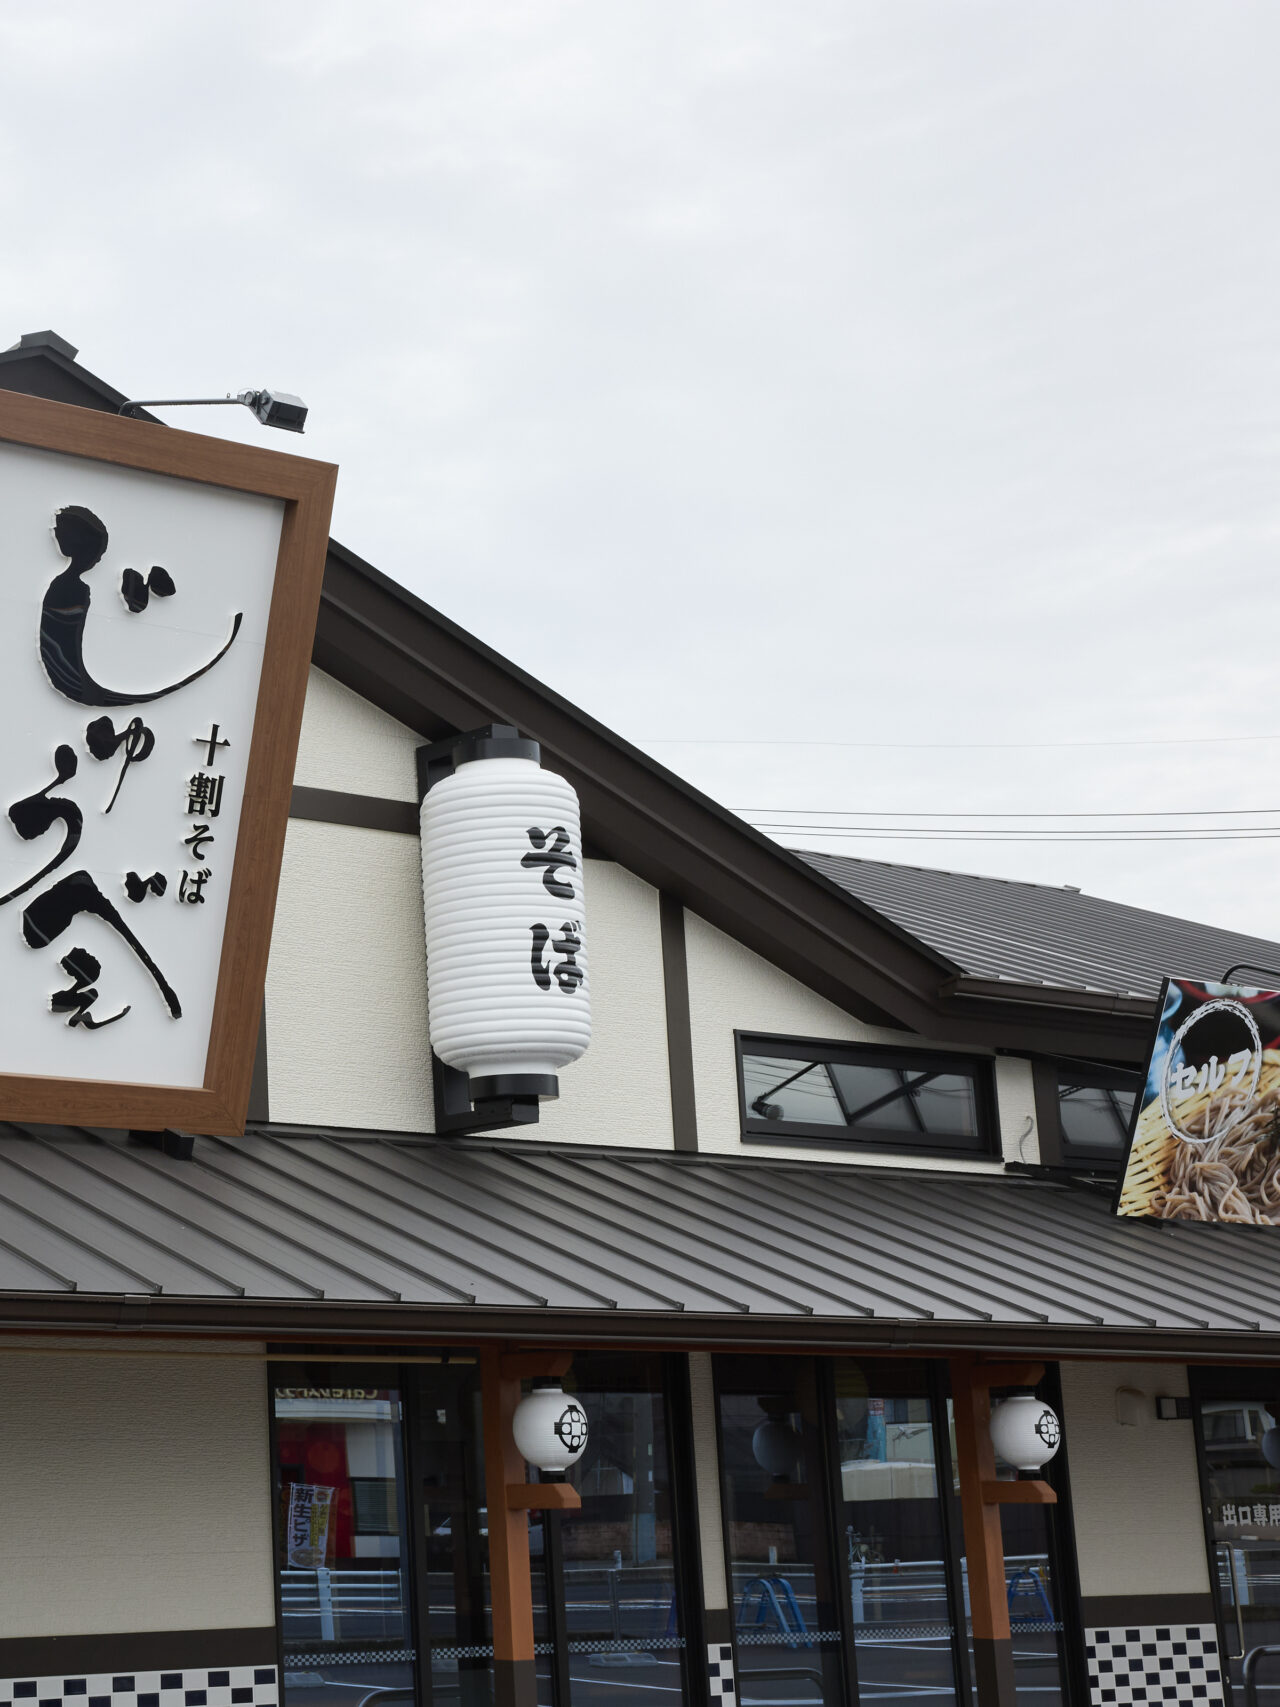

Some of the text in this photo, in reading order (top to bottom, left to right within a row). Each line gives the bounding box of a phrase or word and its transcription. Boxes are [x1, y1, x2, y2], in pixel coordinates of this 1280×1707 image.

[178, 723, 231, 905] 十割そば
[520, 825, 584, 994] そば
[1171, 1048, 1252, 1096] セルフ
[1222, 1503, 1280, 1527] 出口専用
